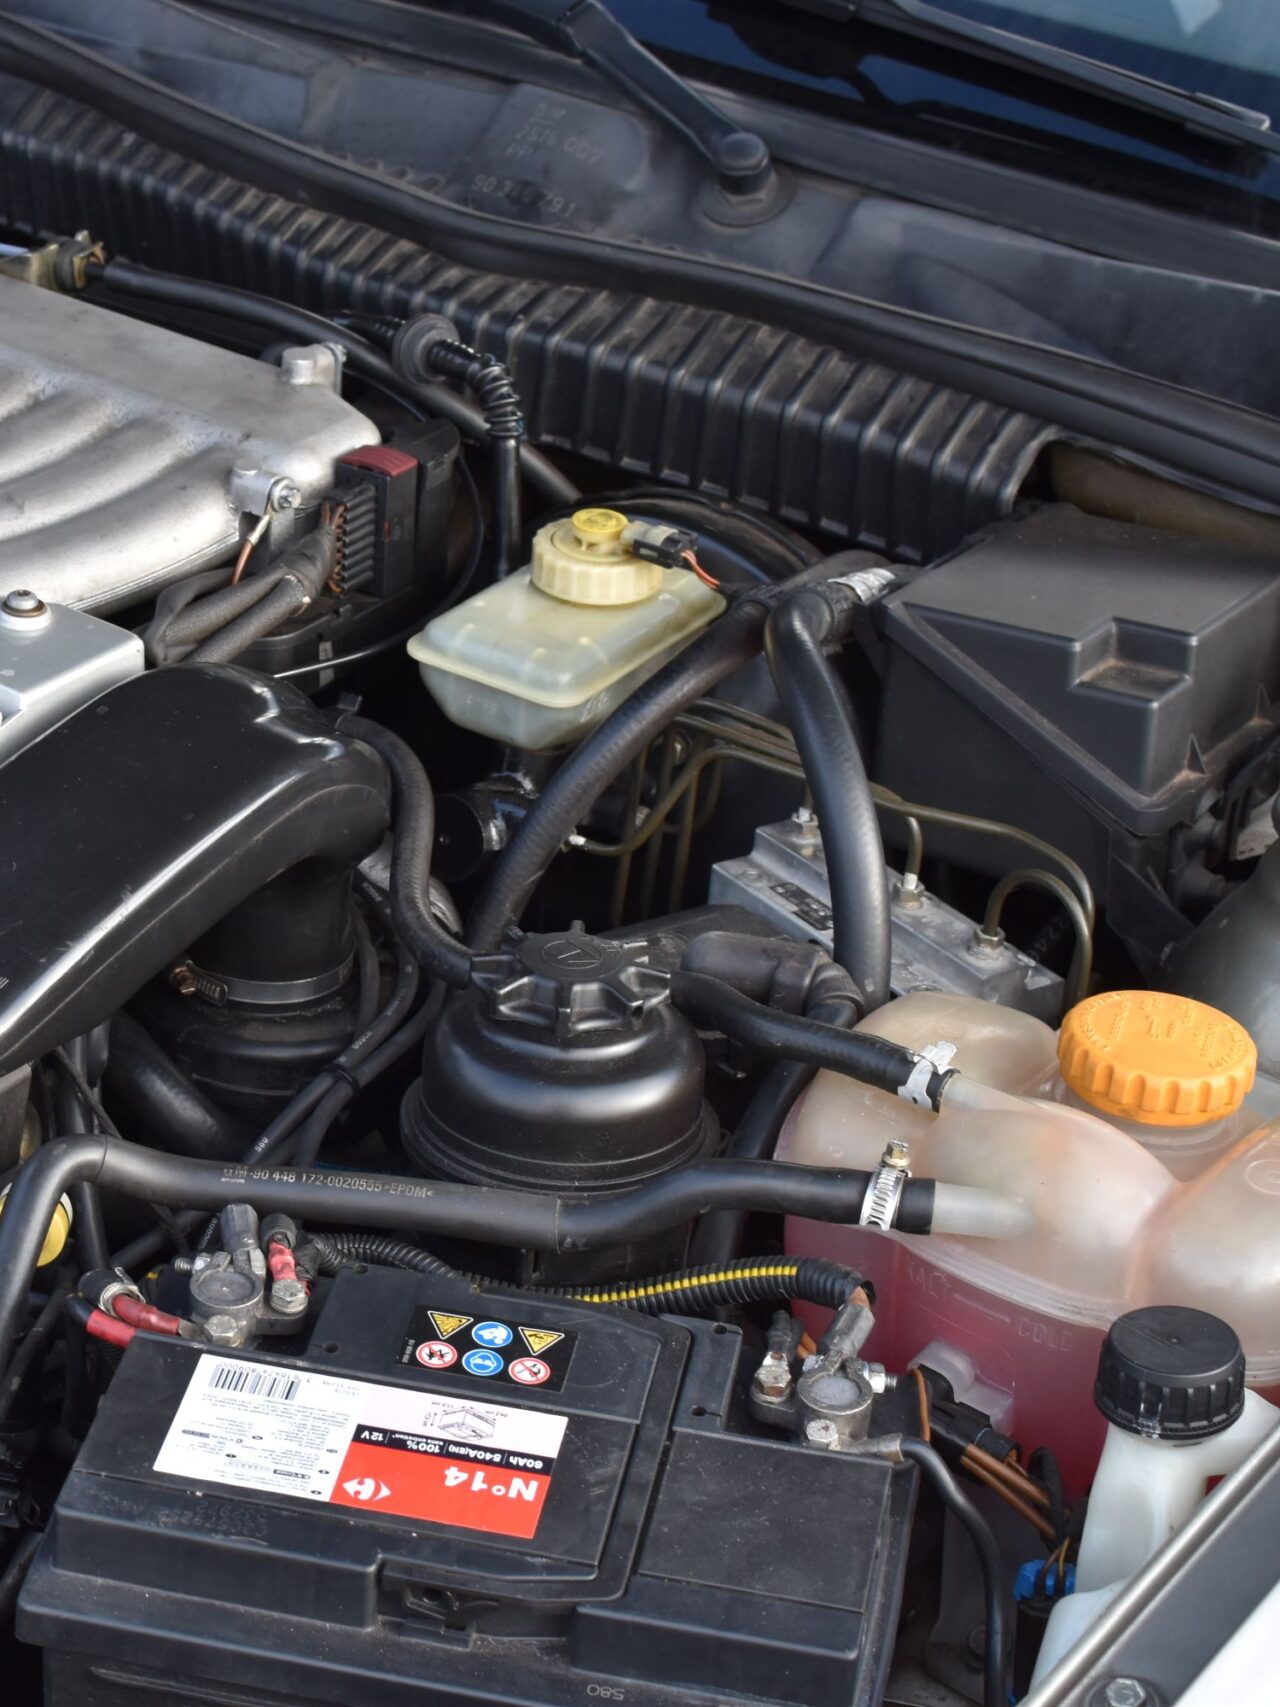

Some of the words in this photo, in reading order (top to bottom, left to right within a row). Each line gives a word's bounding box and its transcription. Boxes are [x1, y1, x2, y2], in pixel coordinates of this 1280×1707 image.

[272, 1171, 297, 1183] 448
[407, 1440, 441, 1454] 100%
[448, 1445, 503, 1463] 540A(EN)
[509, 1455, 543, 1470] 60Ah
[586, 1683, 625, 1701] 580
